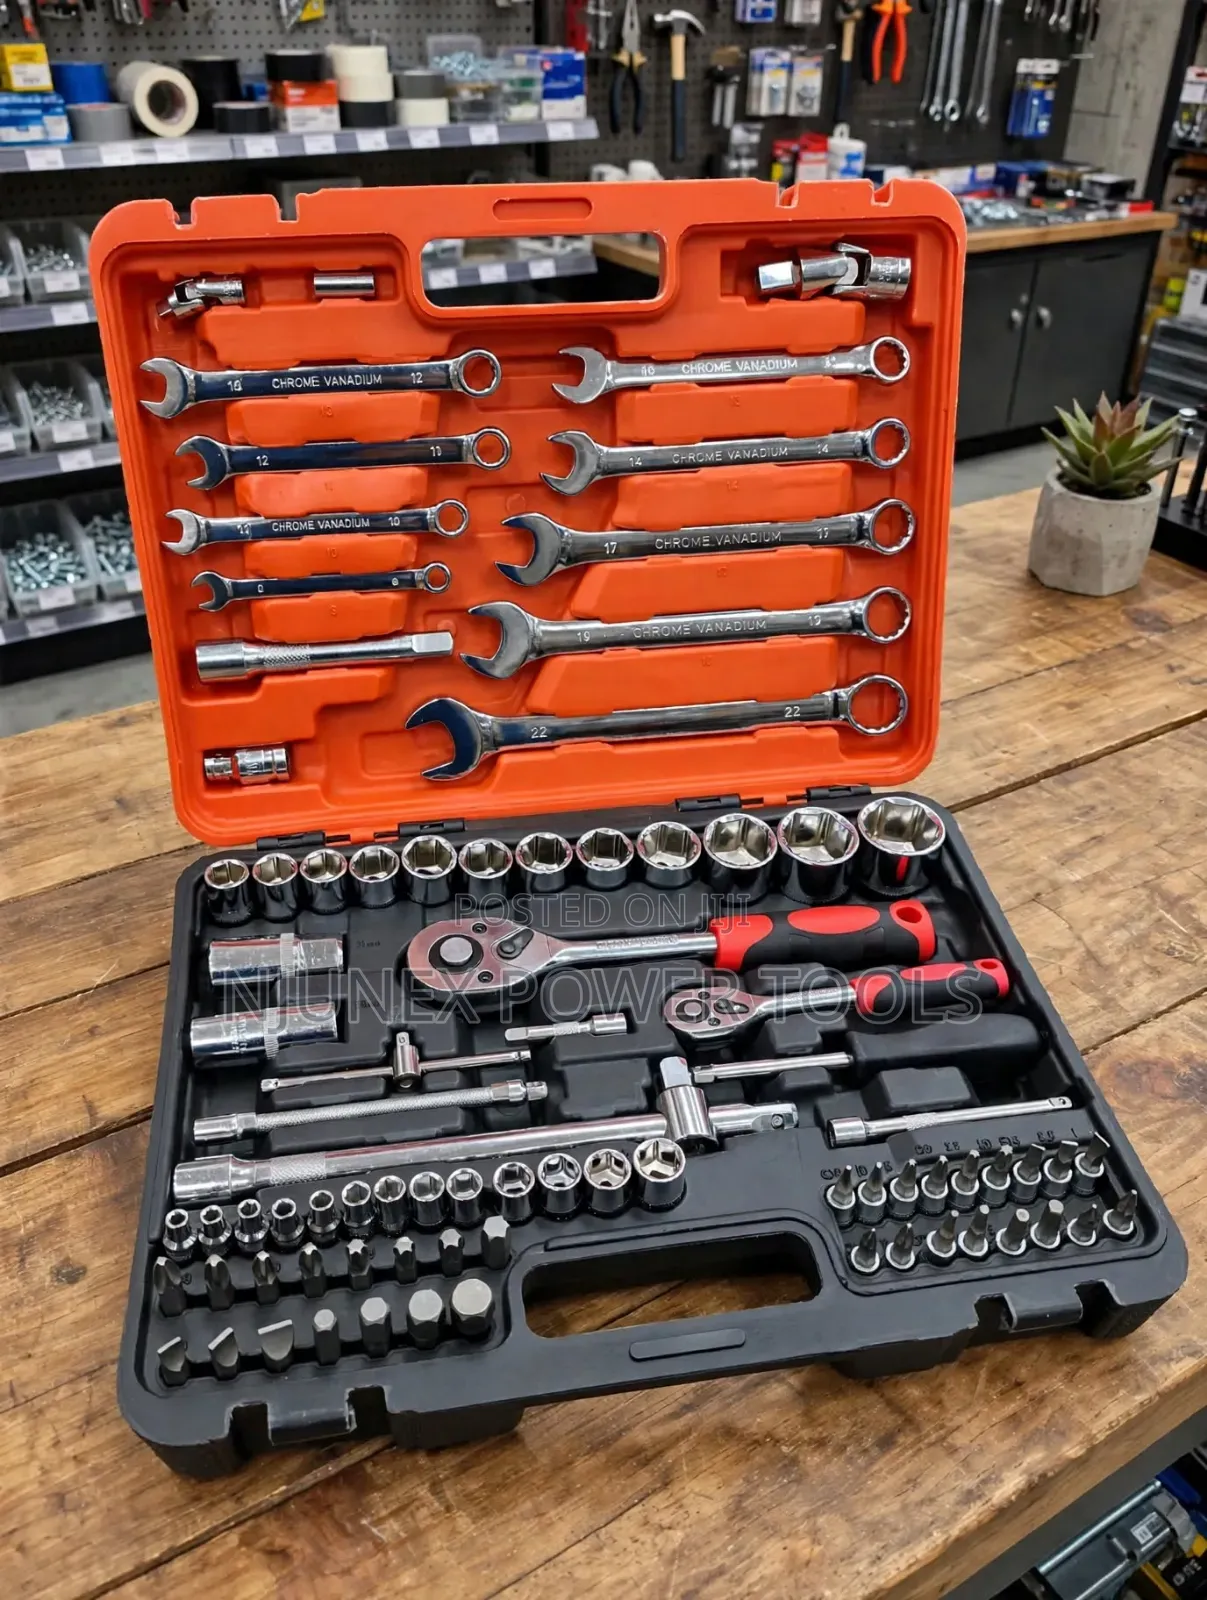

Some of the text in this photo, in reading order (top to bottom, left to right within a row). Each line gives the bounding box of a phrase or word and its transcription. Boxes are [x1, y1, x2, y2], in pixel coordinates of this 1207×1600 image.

[681, 360, 733, 375] CHROME
[735, 358, 798, 371] VANADIUM
[271, 375, 320, 389] CHROME
[324, 373, 383, 386] VANADIUM
[410, 371, 424, 384] 12
[256, 454, 270, 467] 12
[628, 456, 643, 467] 14
[671, 450, 723, 464] CHROME
[727, 447, 788, 460] VANADIUM
[271, 519, 315, 532] CHROME
[317, 517, 371, 530] VANADIUM
[388, 516, 401, 527] 10
[603, 541, 617, 554] 17
[655, 535, 710, 549] CHROME
[716, 531, 782, 546] VANADIUM
[576, 630, 591, 642] 19
[632, 623, 691, 638] CHROME
[696, 619, 767, 634] VANADIUM
[530, 705, 801, 739] 22 22
